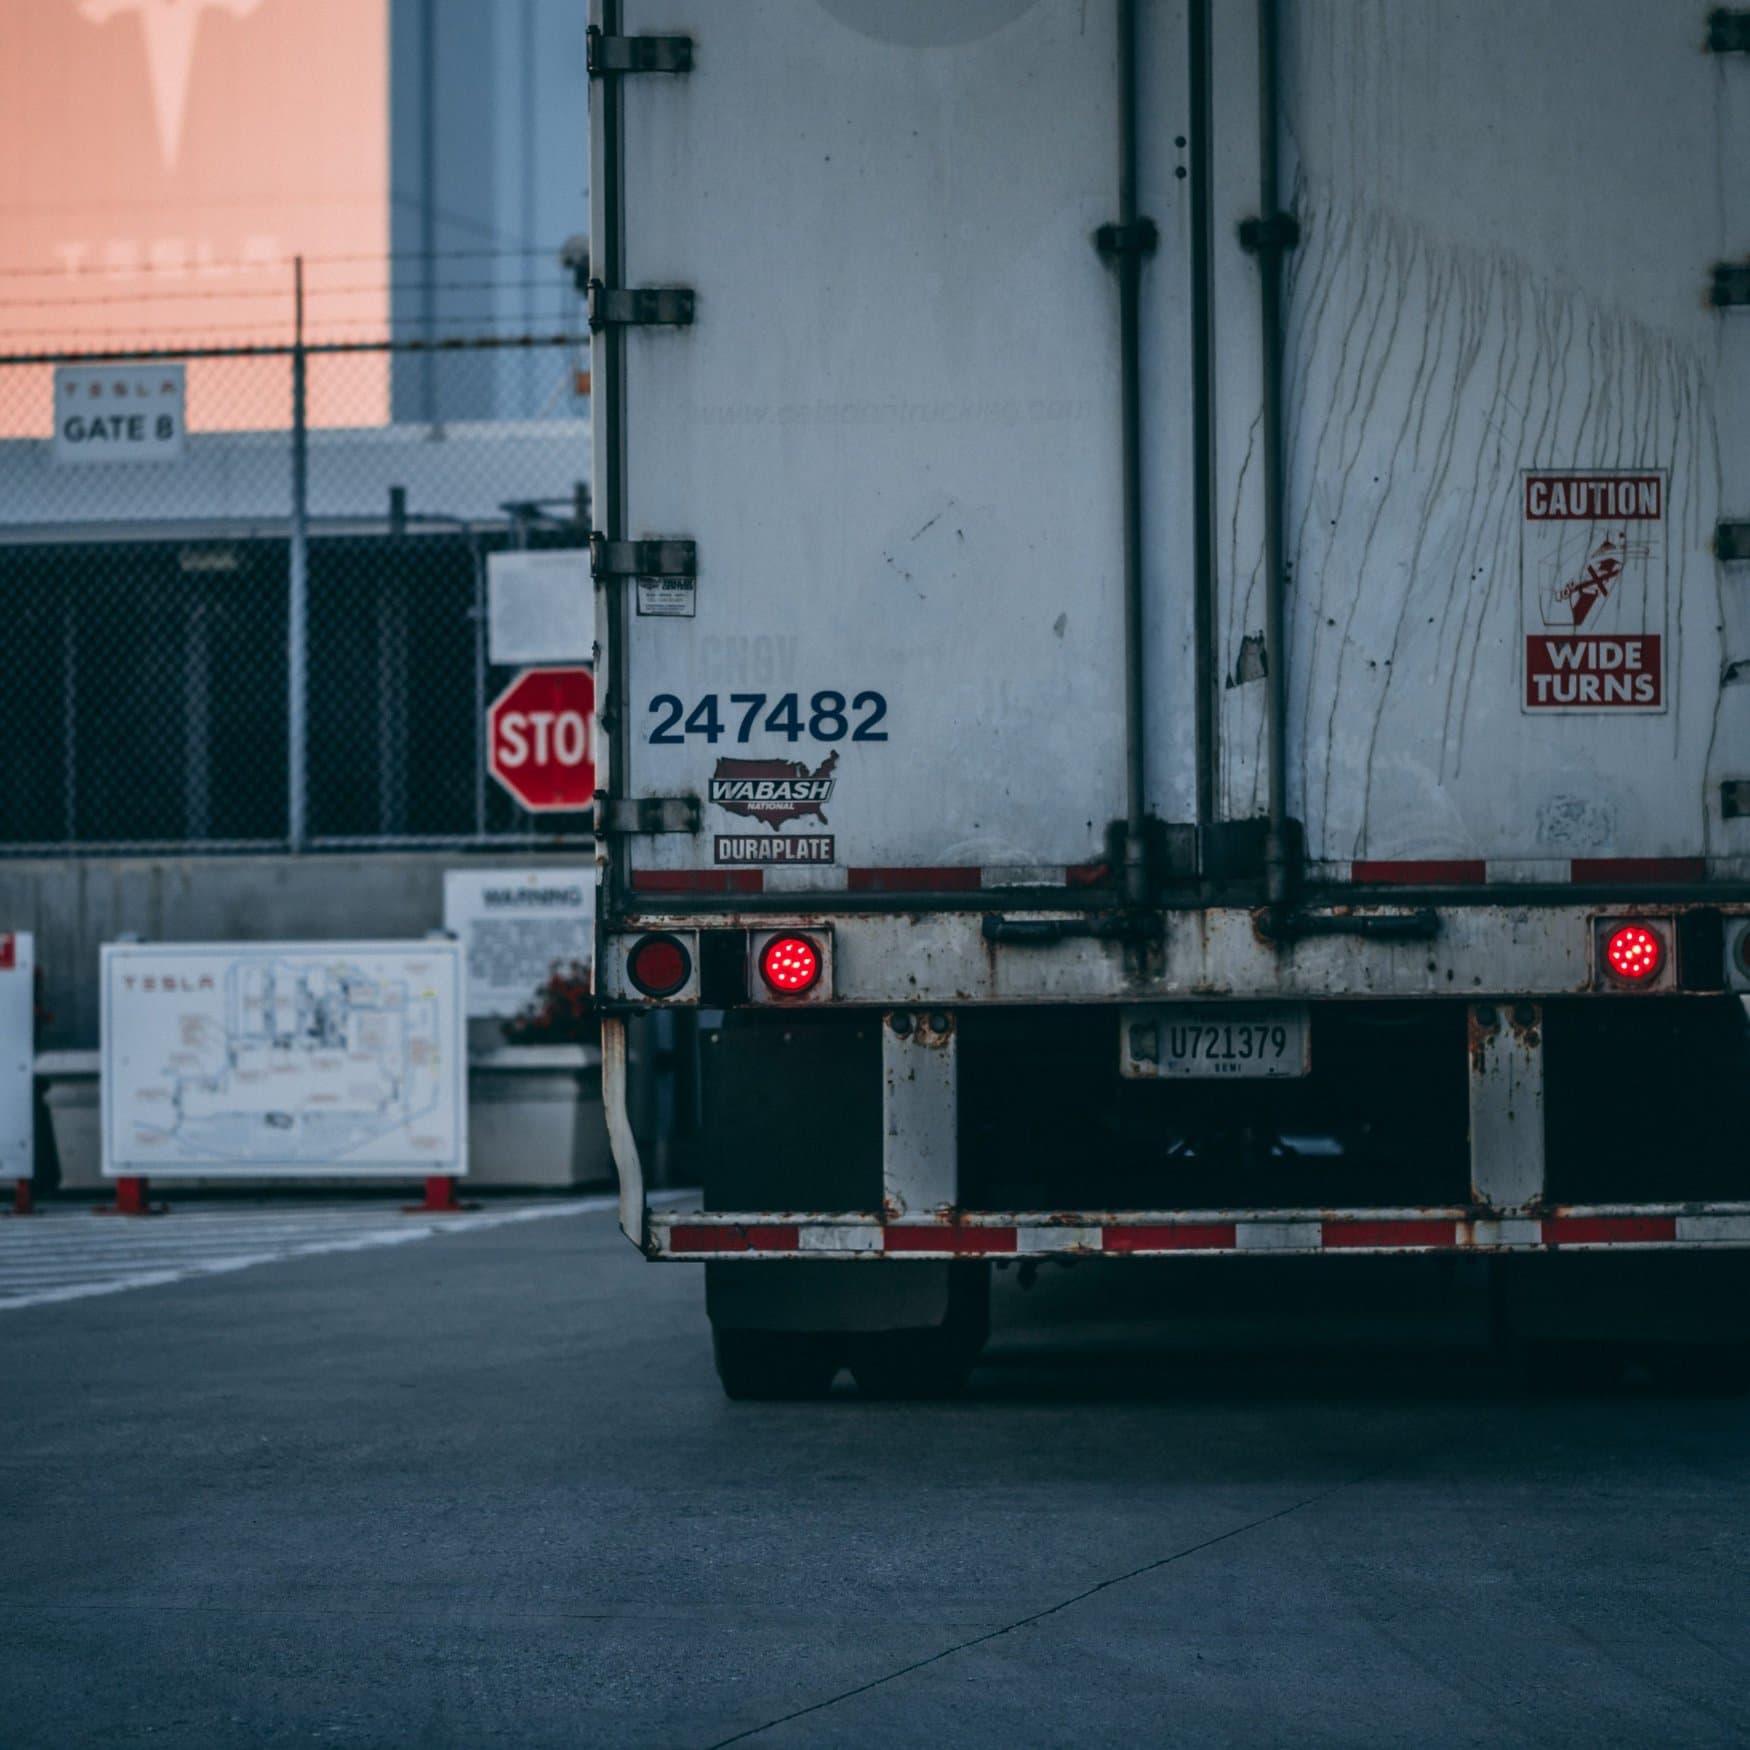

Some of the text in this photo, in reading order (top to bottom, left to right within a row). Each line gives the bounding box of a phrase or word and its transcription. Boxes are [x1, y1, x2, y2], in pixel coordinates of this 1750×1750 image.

[63, 414, 146, 443] GATE
[1529, 481, 1657, 516] CAUTION
[1546, 642, 1642, 670] WIDE
[1533, 674, 1654, 703] TURNS
[649, 690, 889, 744] 247482
[712, 781, 832, 800] WABASH
[747, 802, 795, 811] NATIONAL
[719, 838, 831, 860] DURAPLATE
[1171, 1025, 1287, 1059] U721379
